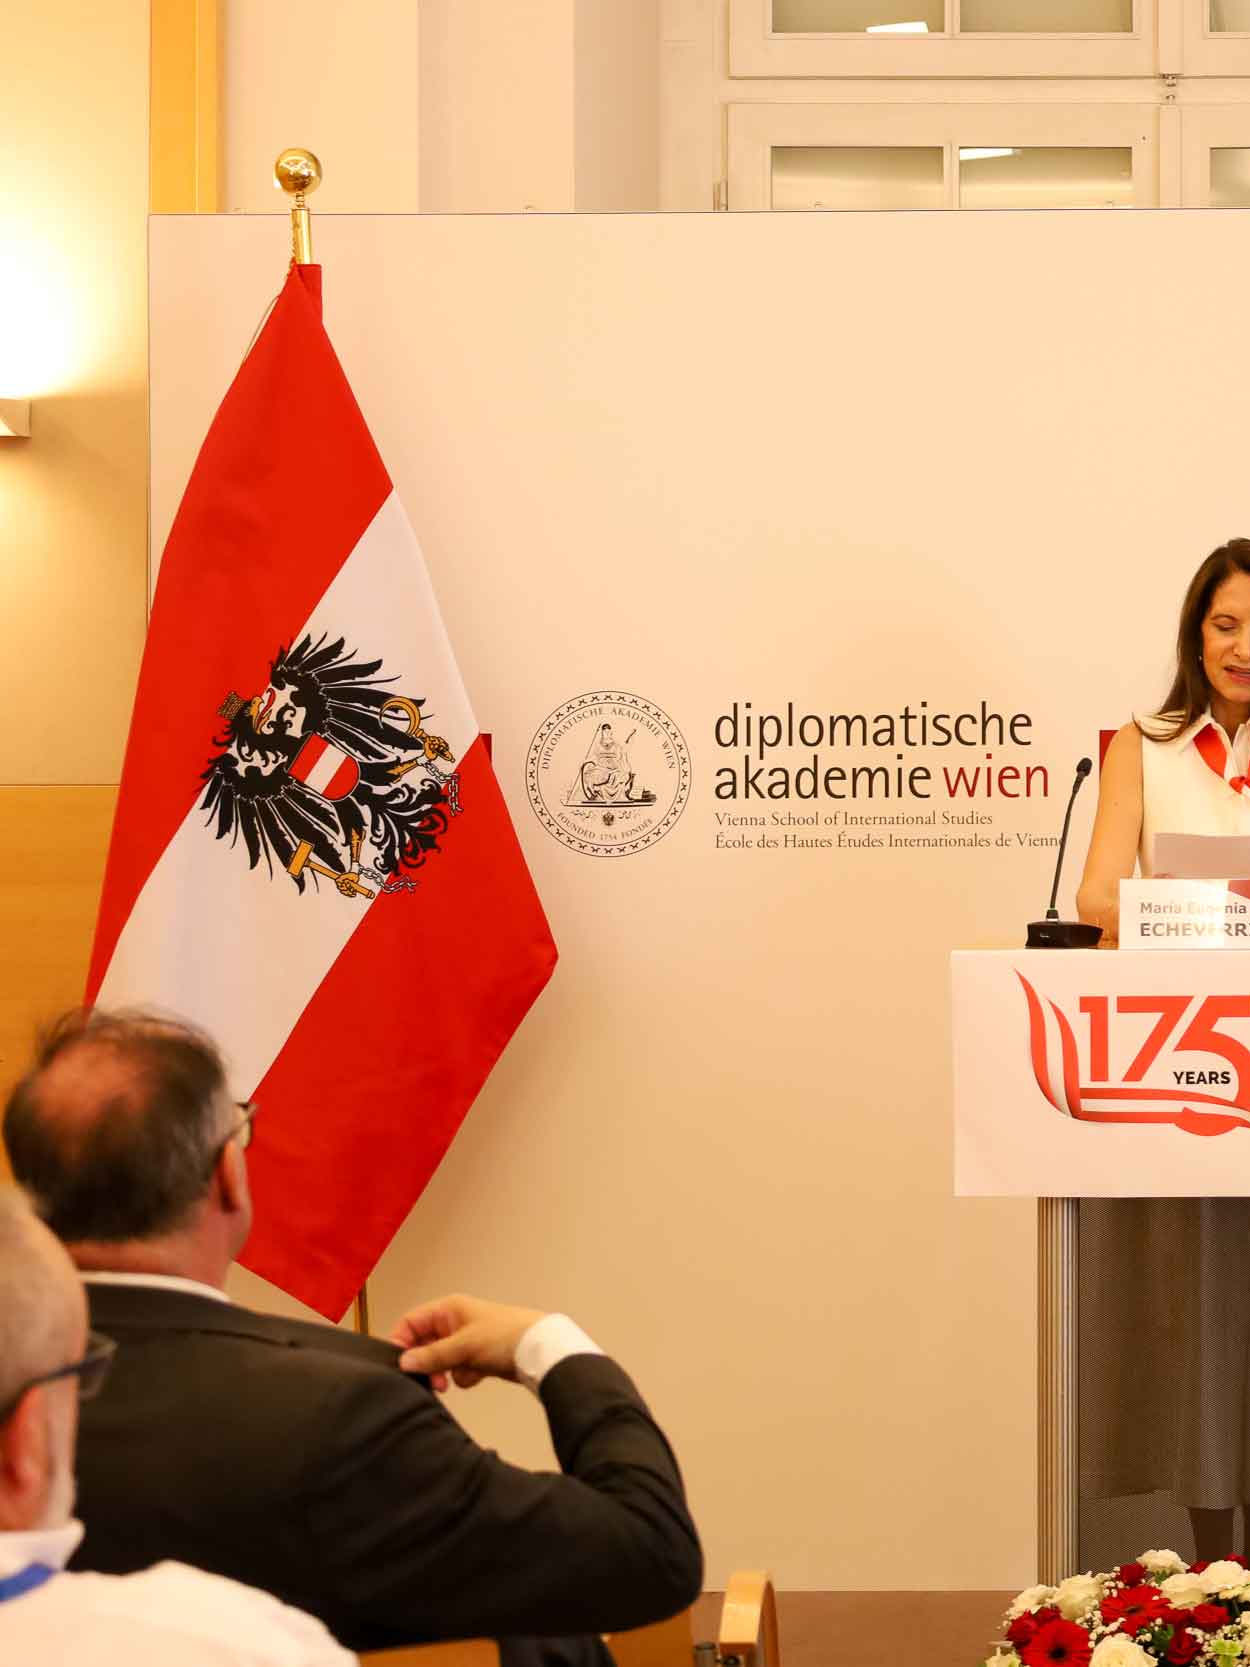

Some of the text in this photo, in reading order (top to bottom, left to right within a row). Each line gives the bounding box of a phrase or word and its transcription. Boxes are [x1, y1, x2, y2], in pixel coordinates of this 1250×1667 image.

[715, 702, 1033, 760] diplomatische
[715, 752, 1049, 799] akademie wien
[714, 810, 993, 827] Vienna School of International Studies
[716, 830, 1062, 849] École des Hautes Études Internationales de Vienn
[1173, 1071, 1231, 1086] YEARS
